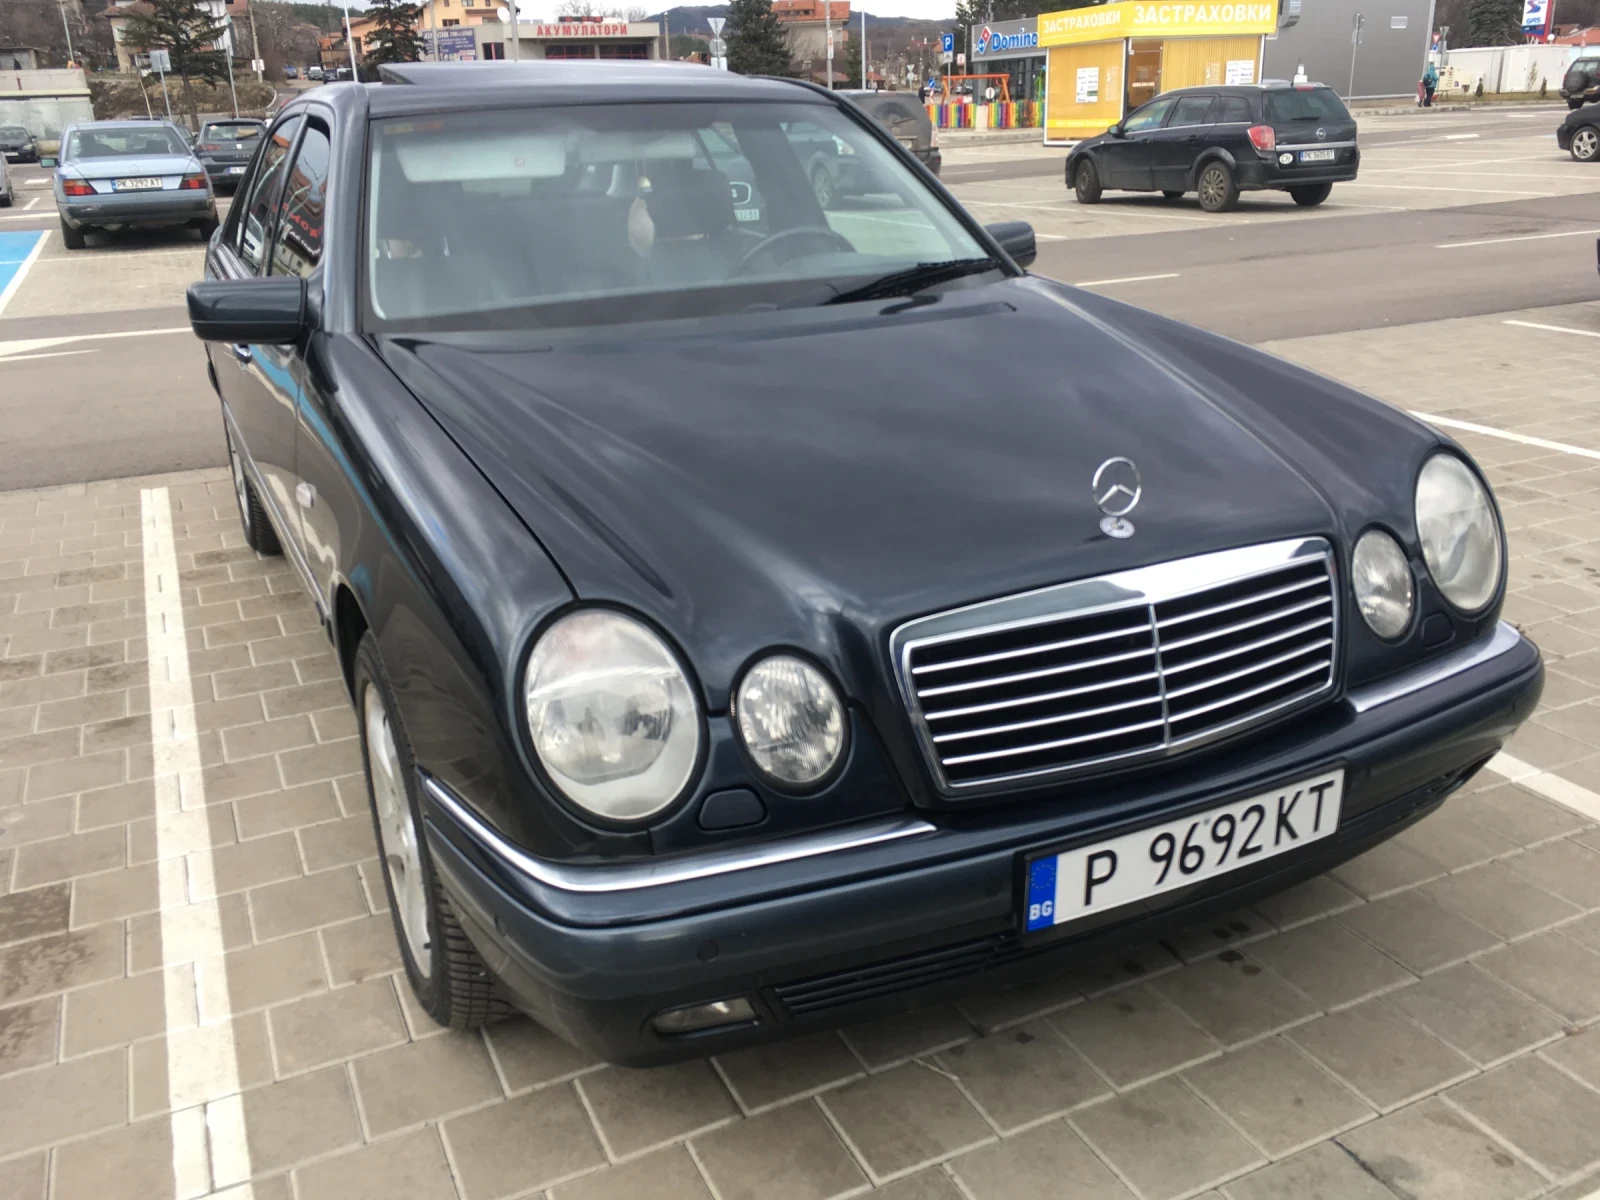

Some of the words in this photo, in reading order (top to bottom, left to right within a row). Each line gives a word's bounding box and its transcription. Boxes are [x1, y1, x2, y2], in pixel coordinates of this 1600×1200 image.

[1043, 10, 1121, 33] ЗАСТРАХОВКИ
[1134, 4, 1271, 24] ЗАСТРАХОВКИ
[537, 24, 627, 36] АКУМУЛАТОРИ
[945, 37, 951, 49] P
[1083, 849, 1118, 907] P
[1029, 901, 1053, 921] BG
